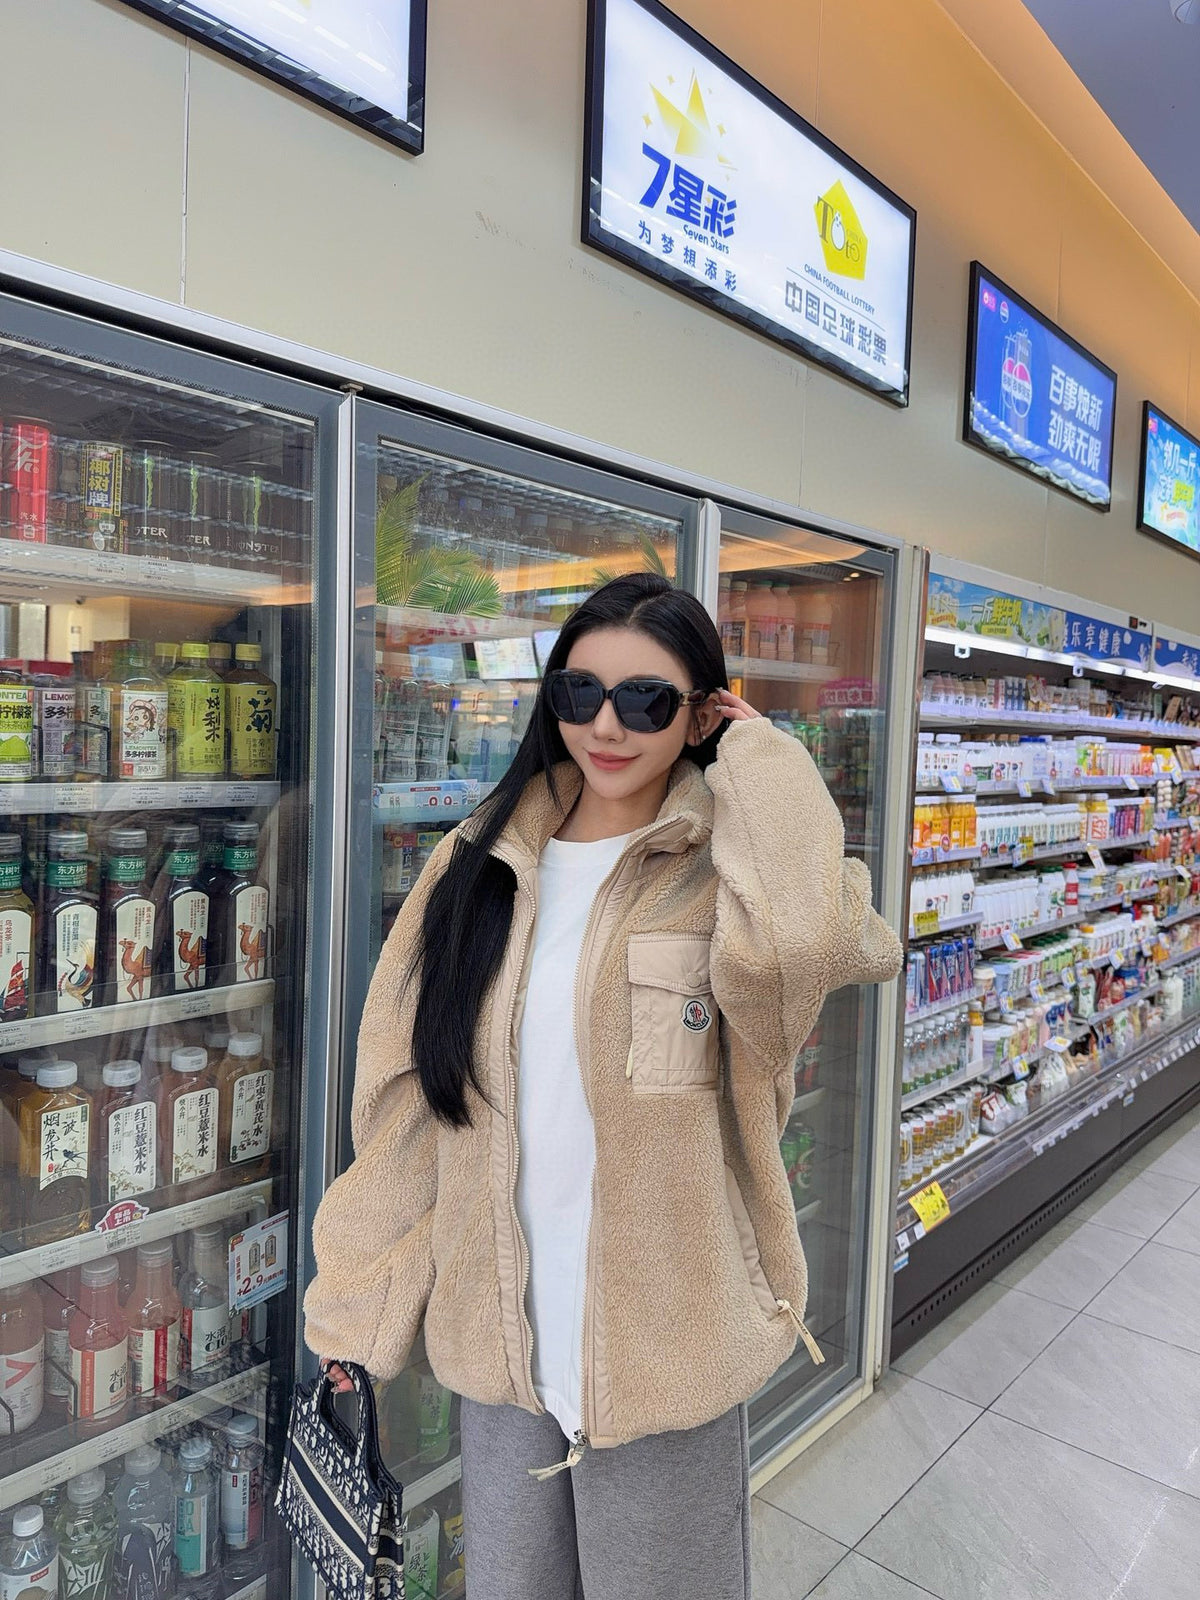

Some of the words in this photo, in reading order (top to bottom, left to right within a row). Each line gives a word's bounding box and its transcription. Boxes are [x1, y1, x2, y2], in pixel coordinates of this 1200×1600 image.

[639, 142, 737, 238] 7星彩
[638, 220, 737, 292] 为梦想添彩
[683, 224, 709, 245] Seven
[710, 236, 730, 255] Stars
[804, 263, 823, 282] CHINA
[822, 276, 850, 301] FOOTBALL
[851, 295, 875, 315] LOTTERY
[785, 280, 887, 366] 中国足球彩票
[1049, 364, 1103, 432] 百事焕新
[1047, 408, 1102, 474] 劲爽无限
[88, 459, 111, 507] 椰树牌
[245, 697, 273, 734] 菊
[124, 750, 157, 758] 多多柠檬茶
[685, 1017, 708, 1028] MONCLER
[133, 1106, 148, 1175] 红豆薏米水
[197, 1092, 212, 1158] 红豆薏米水
